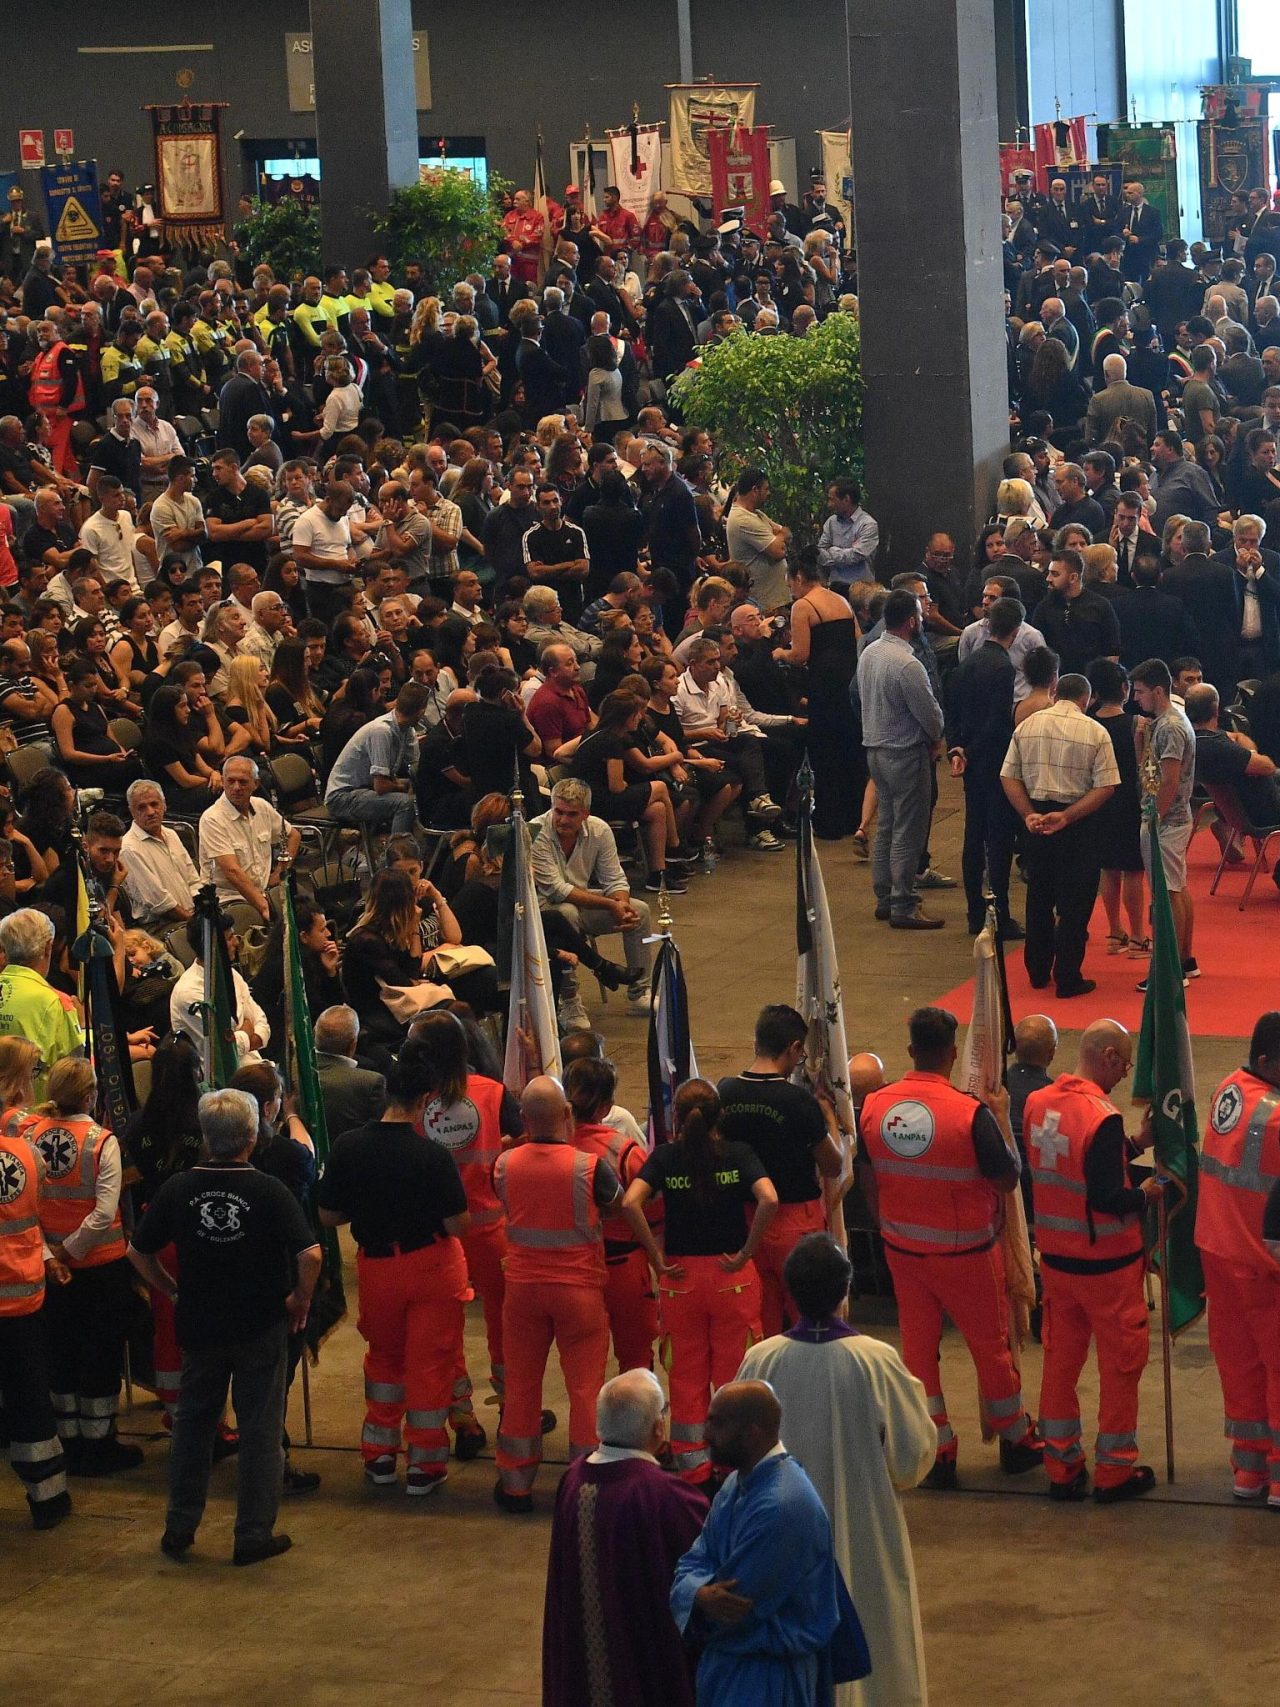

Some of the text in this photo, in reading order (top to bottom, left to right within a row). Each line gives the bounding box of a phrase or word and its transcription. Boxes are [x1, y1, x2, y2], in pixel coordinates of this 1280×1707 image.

[443, 1122, 474, 1134] ANPAS
[898, 1133, 926, 1142] ANPAS
[665, 1169, 741, 1190] SOCCTORE
[200, 1190, 226, 1199] CROCE
[227, 1192, 251, 1212] BIANCA
